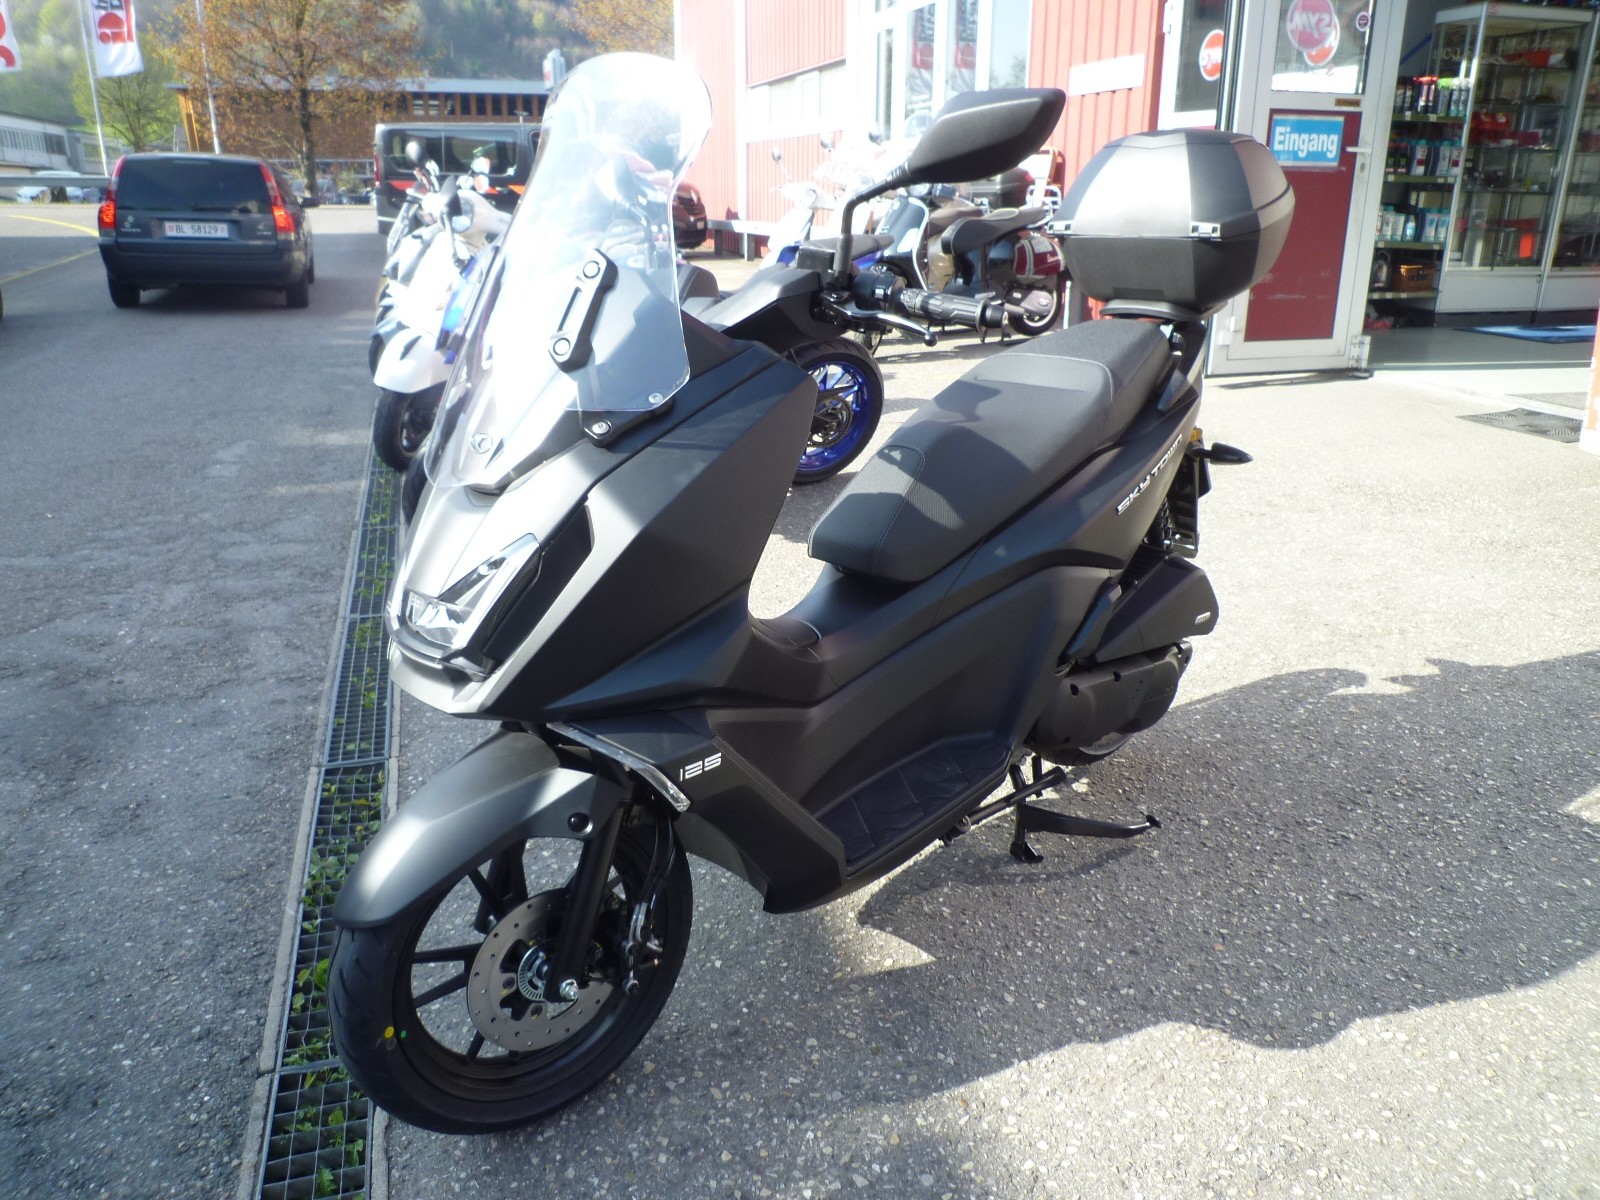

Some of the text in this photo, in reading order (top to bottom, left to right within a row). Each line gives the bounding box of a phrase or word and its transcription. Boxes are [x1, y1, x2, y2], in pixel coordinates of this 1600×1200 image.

[1273, 126, 1339, 158] Eingang
[175, 224, 219, 235] BL 58129
[680, 752, 722, 782] 125
